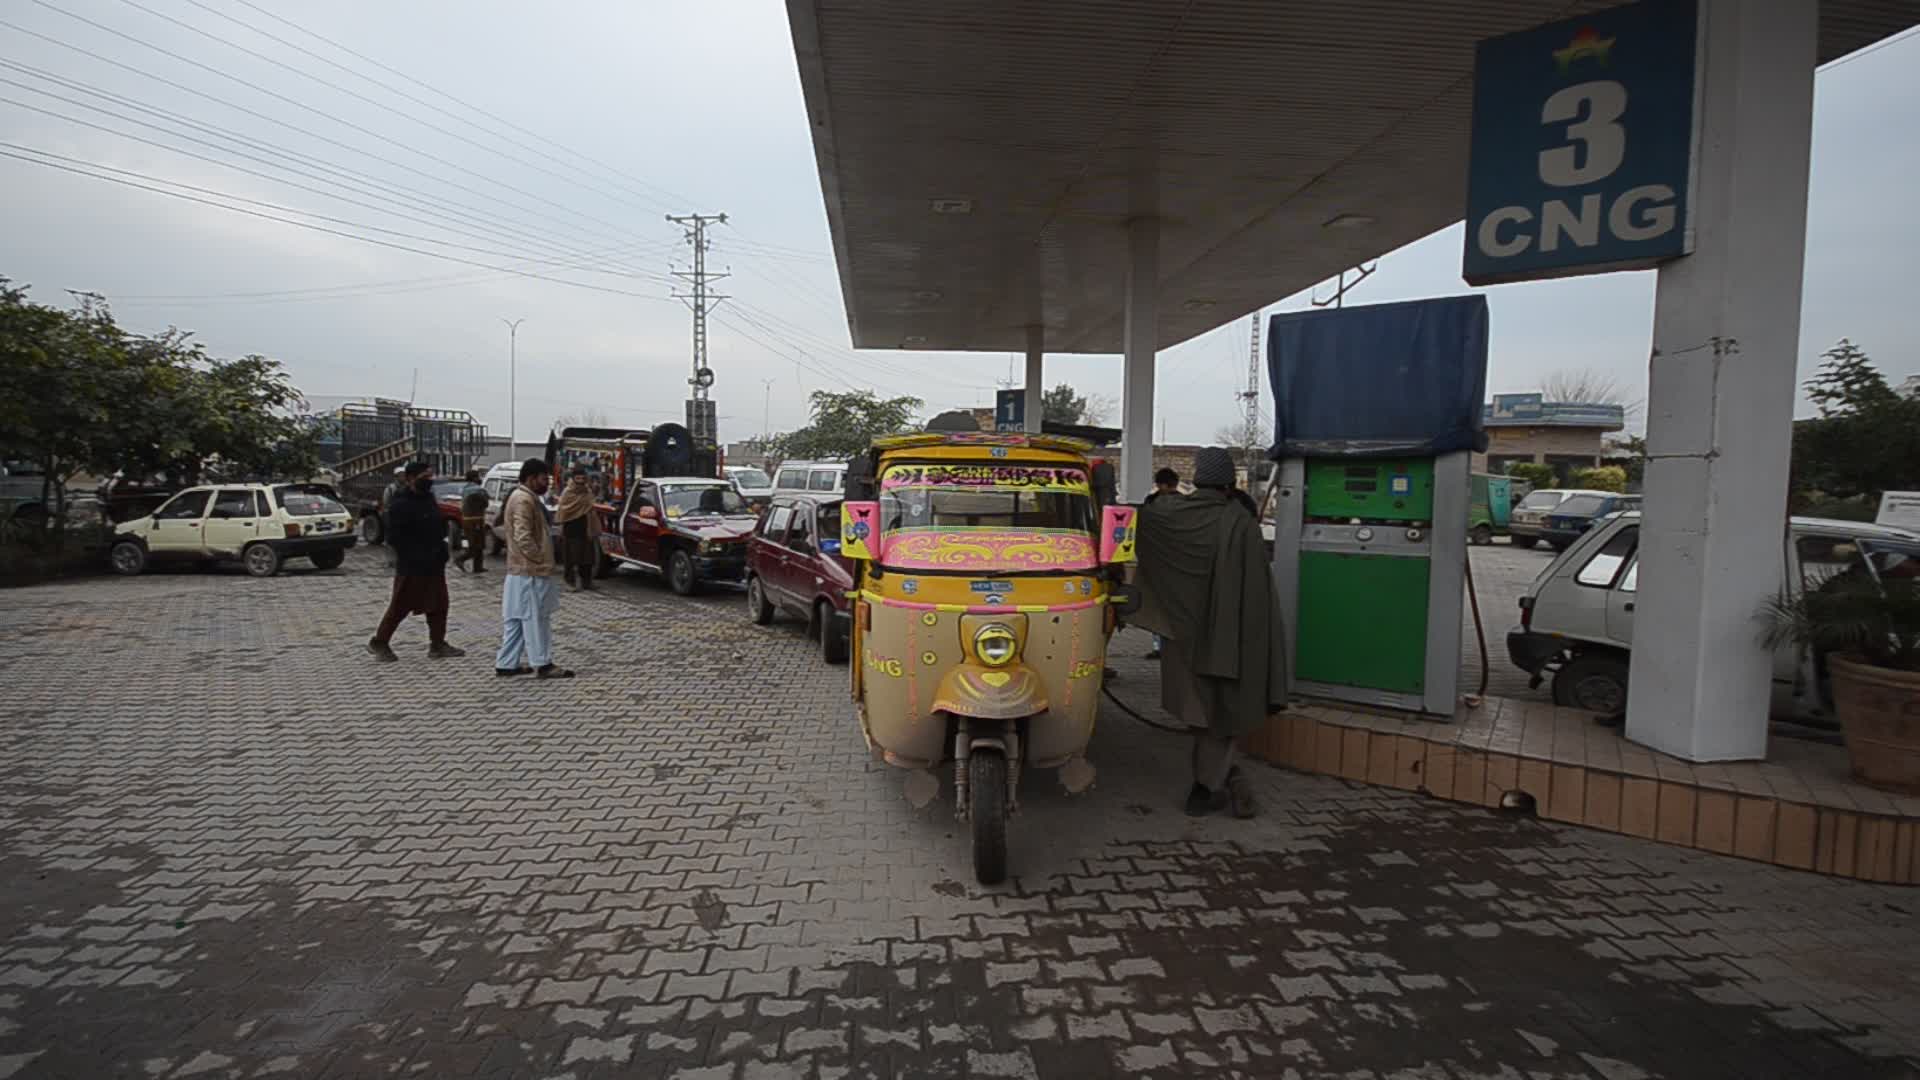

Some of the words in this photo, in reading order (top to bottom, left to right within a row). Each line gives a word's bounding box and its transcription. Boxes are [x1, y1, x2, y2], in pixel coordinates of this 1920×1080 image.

[1538, 80, 1628, 187] 3
[1477, 184, 1676, 257] CNG
[998, 423, 1024, 432] CNG
[1004, 402, 1015, 420] 1
